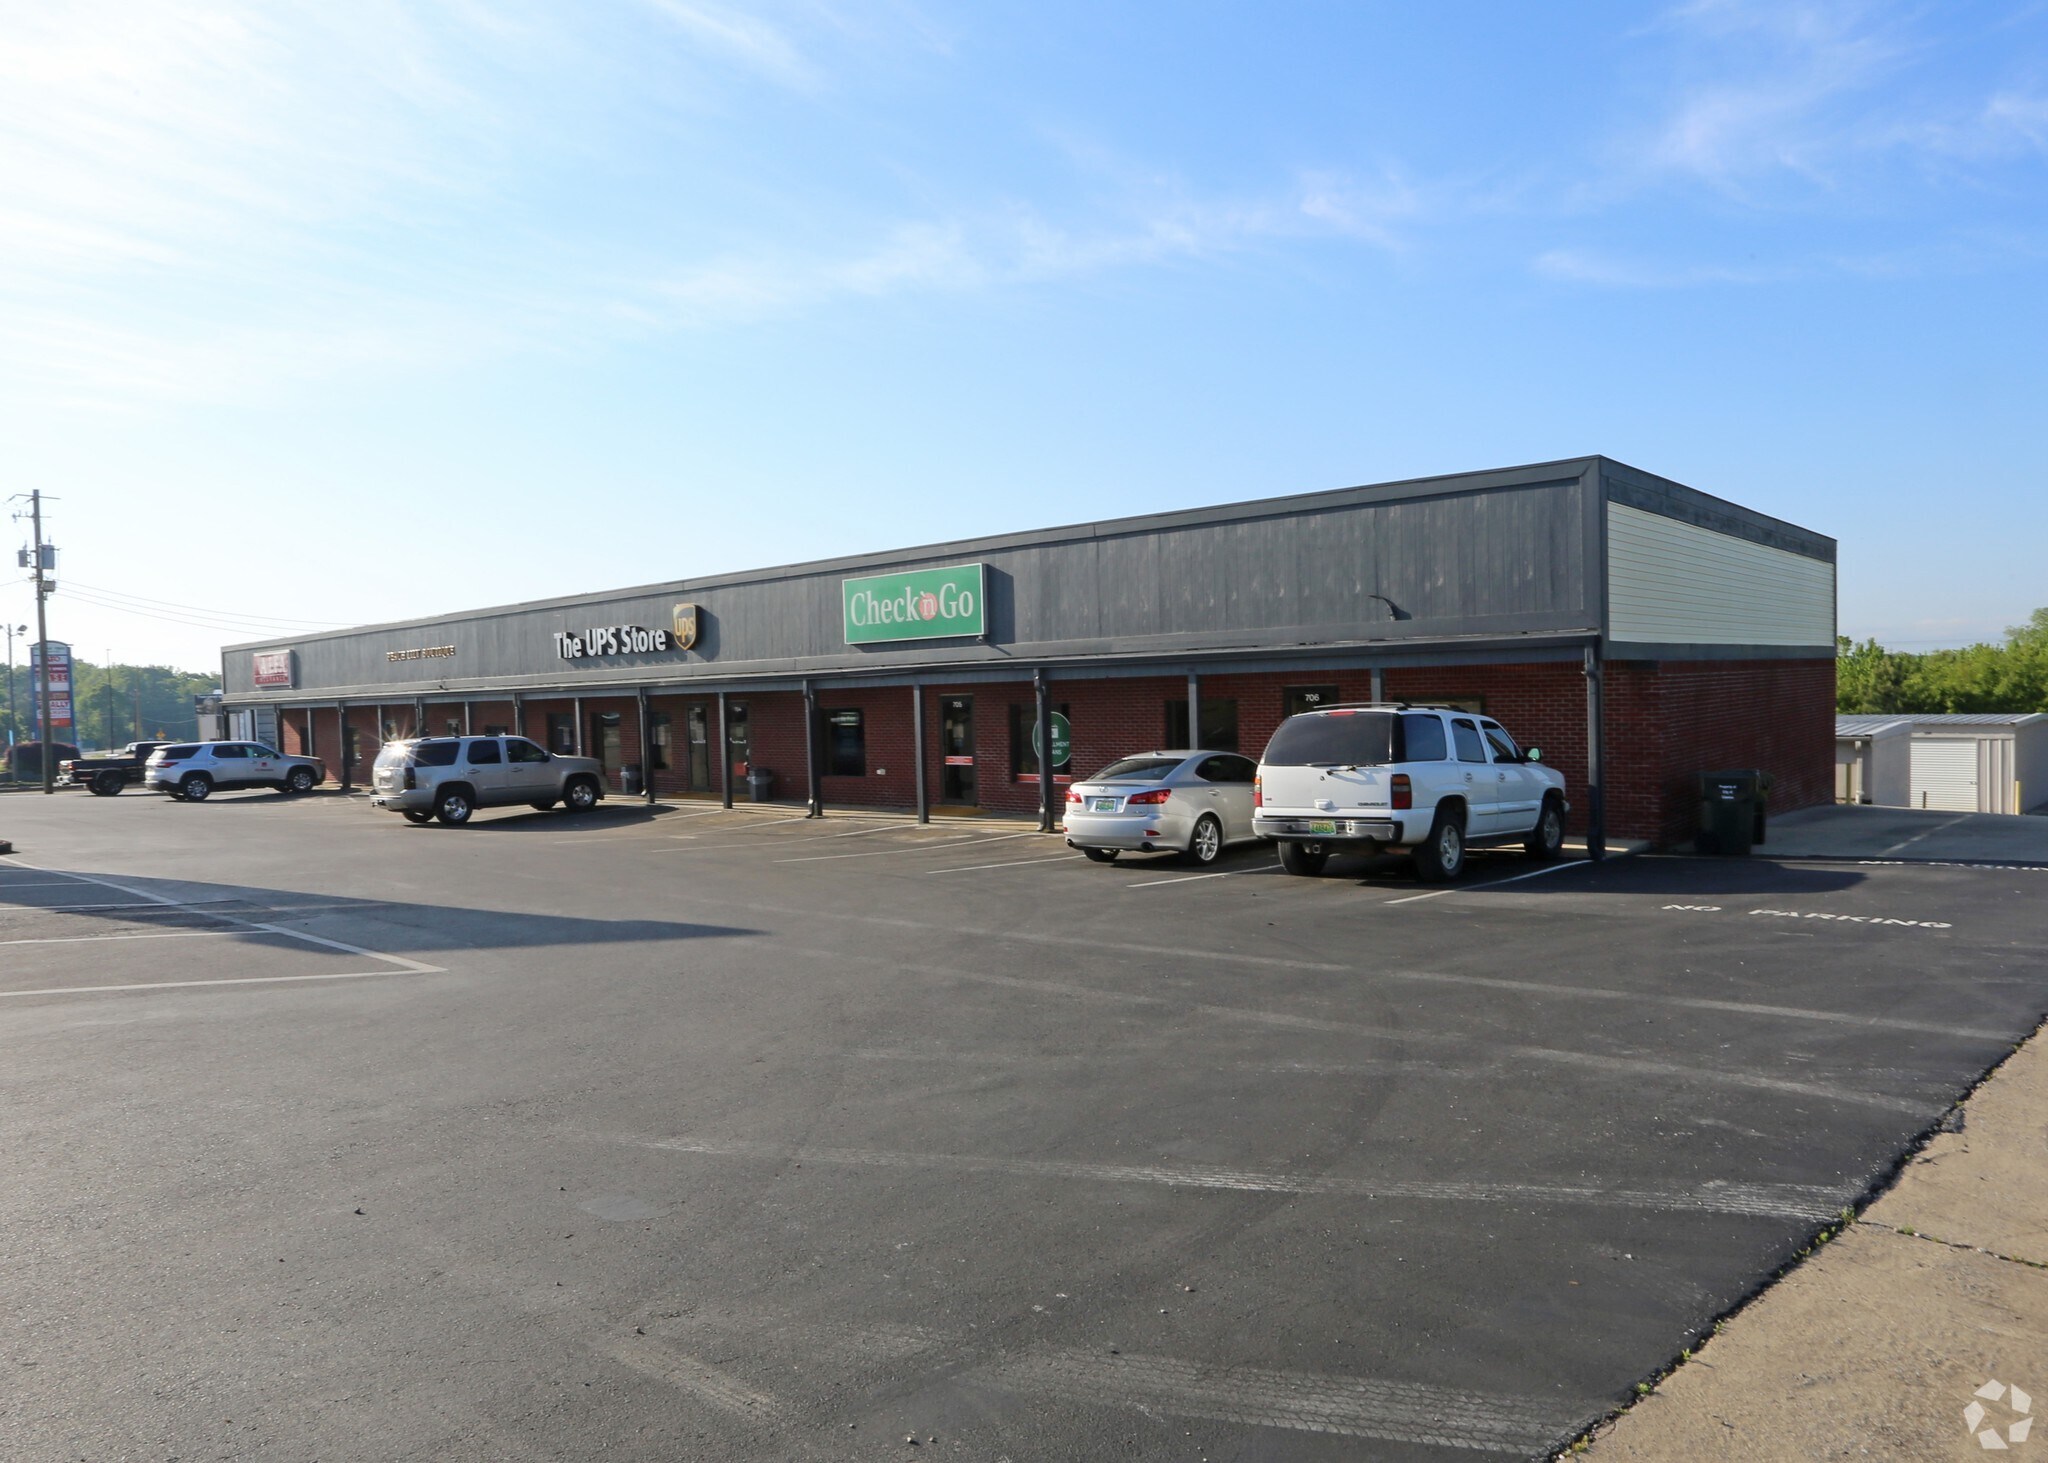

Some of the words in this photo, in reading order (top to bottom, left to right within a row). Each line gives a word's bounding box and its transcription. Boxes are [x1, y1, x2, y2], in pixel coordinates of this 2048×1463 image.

[851, 586, 920, 626] Check
[939, 583, 974, 619] Go
[554, 632, 582, 659] The
[586, 627, 618, 656] UPS
[621, 624, 667, 654] Store
[674, 617, 694, 643] ups
[1304, 693, 1320, 702] 706
[1748, 909, 1953, 928] PARKING
